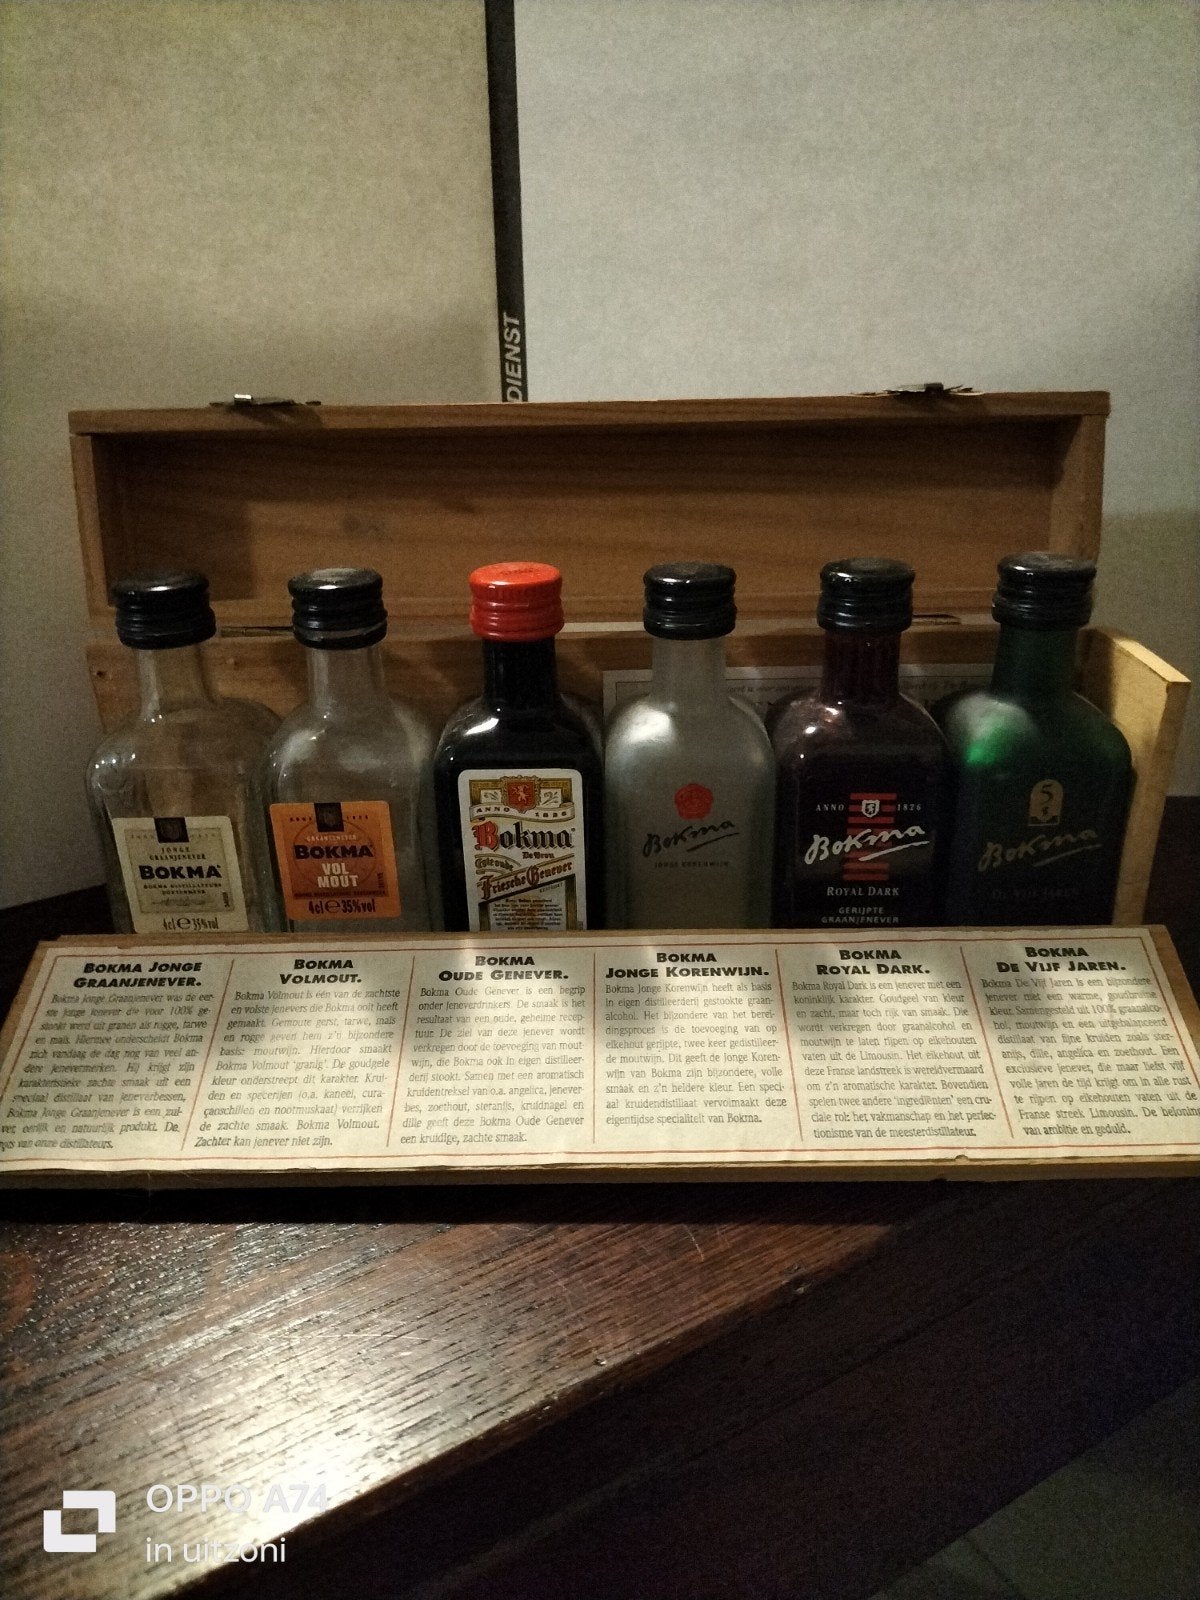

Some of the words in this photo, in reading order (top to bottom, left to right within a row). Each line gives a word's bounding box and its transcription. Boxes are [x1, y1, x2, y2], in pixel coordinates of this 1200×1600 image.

[503, 311, 523, 402] DIENST
[472, 821, 575, 851] Bokma
[804, 826, 929, 864] Bokma
[294, 845, 374, 859] BOKMA
[139, 865, 222, 880] BOKMA
[322, 863, 349, 875] VOL
[317, 875, 358, 888] MOUT
[827, 887, 863, 896] ROYAL
[868, 887, 899, 896] DARK
[308, 901, 323, 914] 4cl
[839, 907, 884, 915] GERIJPTE
[839, 950, 901, 960] BOKMA
[1025, 947, 1089, 957] BOKMA
[475, 956, 535, 966] BOKMA
[657, 953, 717, 963] BOKMA
[84, 963, 142, 973] BOKMA
[148, 962, 202, 972] JONGE
[294, 959, 353, 969] BOKMA
[816, 965, 870, 975] ROYAL
[877, 964, 930, 974] DARK.
[996, 962, 1019, 972] DE
[1025, 962, 1060, 972] VIJF
[1068, 961, 1126, 971] JAREN.
[439, 970, 482, 981] OUDE
[491, 970, 569, 980] GENEVER.
[606, 968, 658, 978] JONGE
[666, 967, 769, 977] KORENWIJN.
[74, 977, 201, 988] GRAANJENEVER.
[280, 974, 362, 984] VOLMOUT.
[420, 987, 449, 997] Bokma
[455, 987, 478, 996] Oude
[485, 986, 519, 995] Genever
[526, 986, 533, 995] is
[560, 985, 585, 997] begrip
[606, 984, 634, 993] Bokma
[638, 983, 661, 995] Jonge
[665, 983, 708, 995] Korenwijn
[712, 982, 733, 991] heeft
[737, 982, 747, 991] als
[752, 982, 771, 991] basis
[606, 1069, 625, 1081] wijn
[652, 1068, 681, 1078] Bokma
[686, 1068, 702, 1080] zijn
[708, 1068, 757, 1079] bijzondere,
[761, 1067, 782, 1076] volle
[805, 1066, 825, 1075] deze
[827, 1066, 854, 1075] Franse
[857, 1066, 902, 1075] landstreek
[904, 1065, 911, 1074] is
[914, 1065, 984, 1074] wereldvermaard
[1014, 1094, 1024, 1103] te
[1030, 1093, 1055, 1106] rijpen
[1062, 1095, 1073, 1105] op
[1135, 1092, 1161, 1101] vaten
[1167, 1091, 1180, 1101] uit
[1185, 1091, 1196, 1101] de
[403, 1118, 421, 1127] dille
[427, 1118, 448, 1129] geeft
[454, 1117, 474, 1126] deze
[480, 1117, 510, 1126] Bokma
[516, 1116, 541, 1126] Oude
[546, 1116, 584, 1125] Genever
[606, 1115, 654, 1126] eigentijdse
[657, 1114, 704, 1126] specialiteit
[708, 1115, 724, 1123] van
[728, 1113, 762, 1122] Bokma.
[200, 1122, 211, 1131] de
[218, 1122, 249, 1131] zachte
[297, 1121, 329, 1130] Bokma
[1044, 1125, 1078, 1135] ambitie
[1095, 1124, 1130, 1137] geduld.
[814, 1128, 853, 1138] tionisme
[876, 1128, 887, 1137] de
[194, 1137, 231, 1147] Zachter
[234, 1137, 251, 1146] kan
[253, 1137, 290, 1148] jenever
[292, 1137, 310, 1146] niet
[312, 1136, 333, 1148] zijn.
